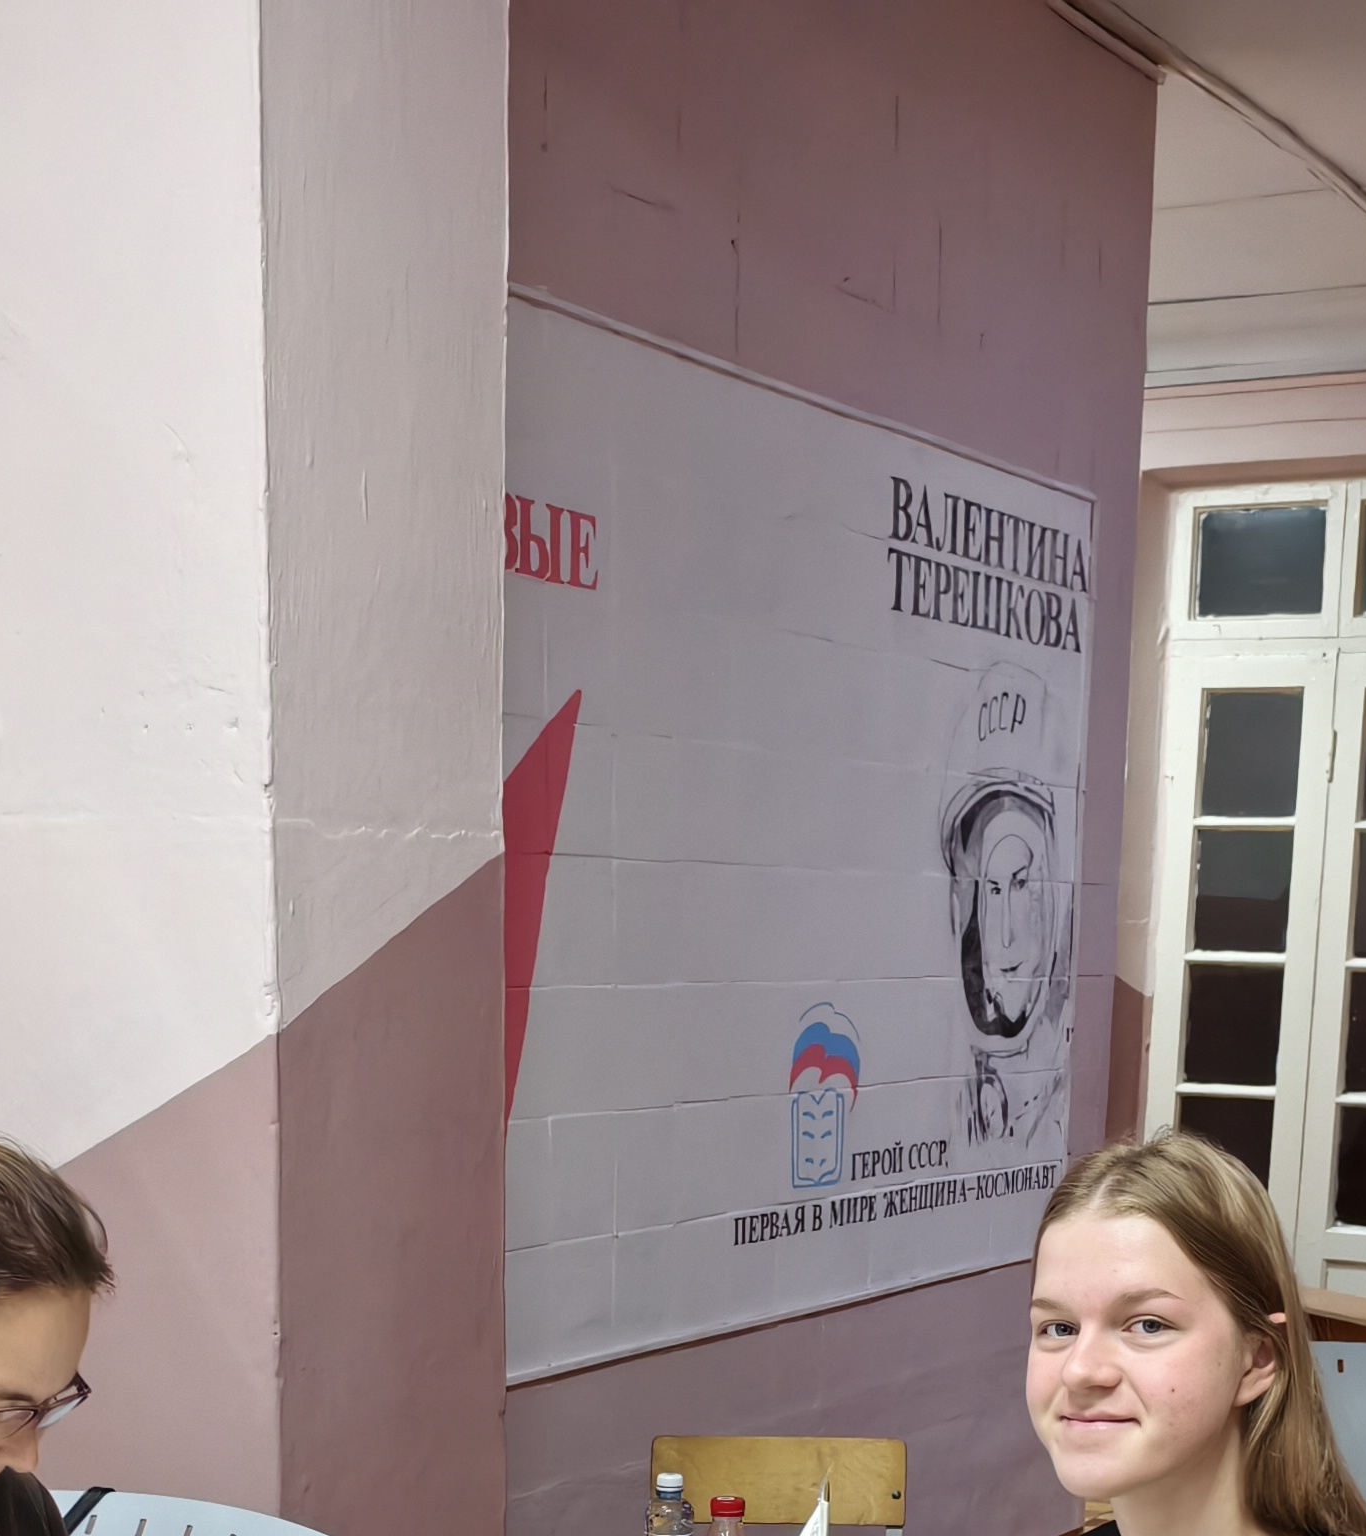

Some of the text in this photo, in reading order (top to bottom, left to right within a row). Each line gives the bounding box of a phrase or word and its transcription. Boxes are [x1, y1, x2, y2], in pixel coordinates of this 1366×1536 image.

[888, 475, 1088, 594] ВАЛЕНТИНА
[887, 547, 1082, 653] ТЕРЕШКОВА
[978, 691, 1027, 742] СССР
[850, 1142, 903, 1181] ГЕРОЙ
[733, 1164, 1057, 1246] ПЕРВАЯ В МИРЕ ЖЕНЩИНА-КОСМОНАВТ
